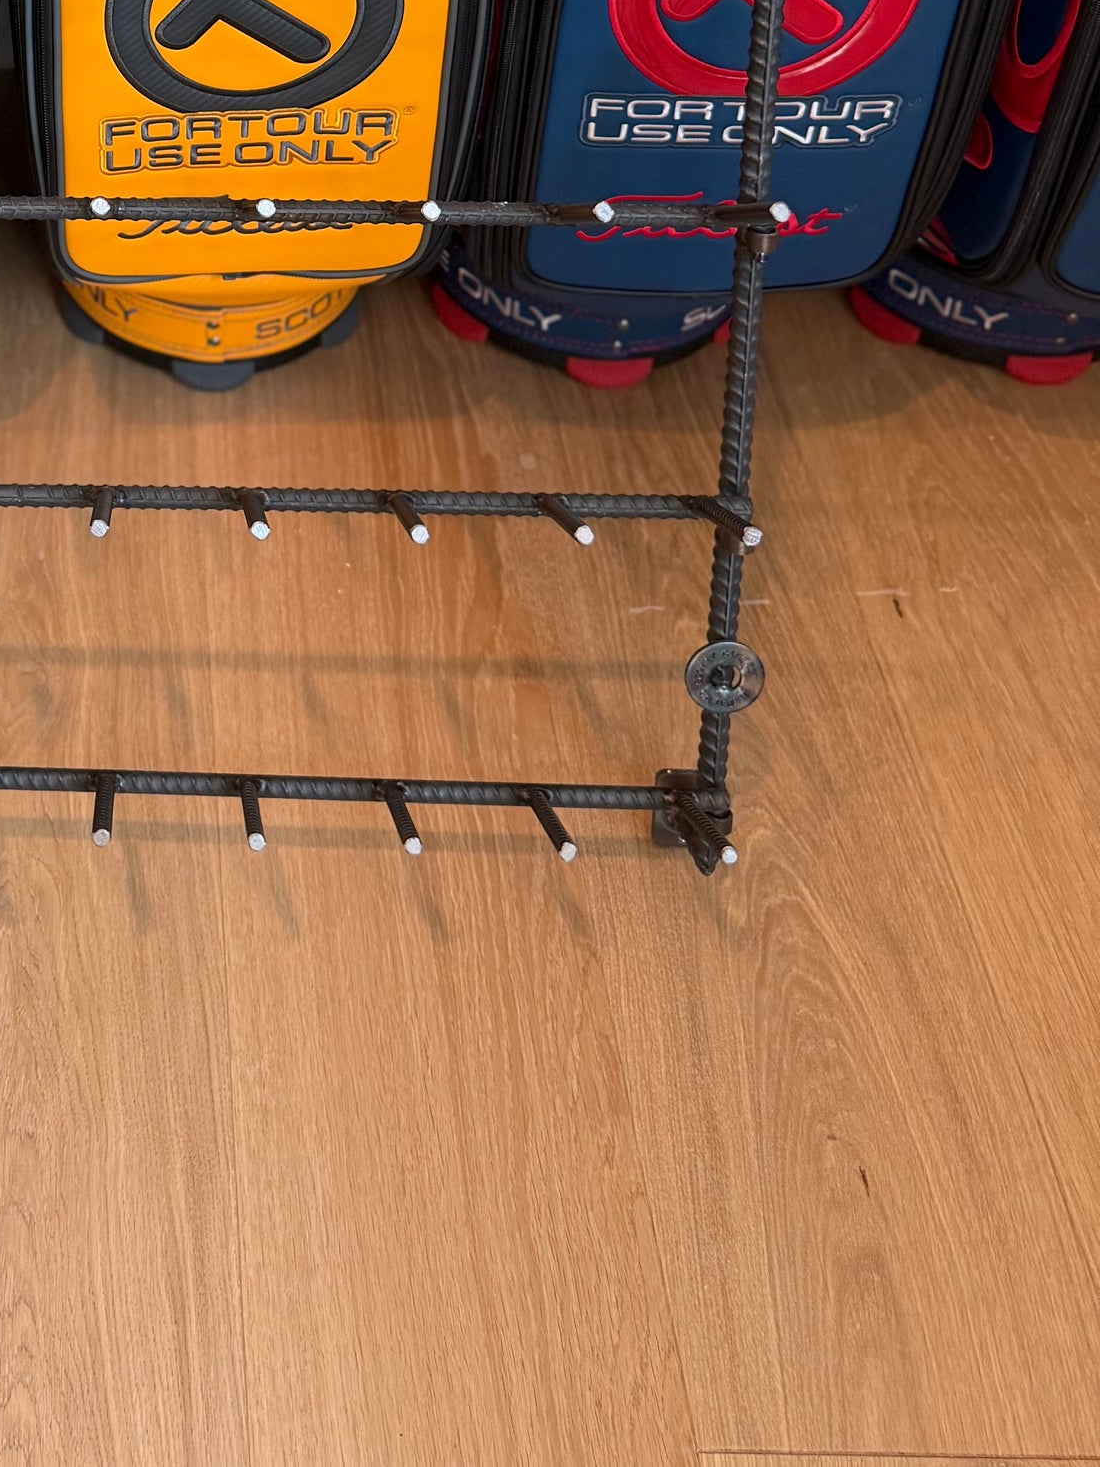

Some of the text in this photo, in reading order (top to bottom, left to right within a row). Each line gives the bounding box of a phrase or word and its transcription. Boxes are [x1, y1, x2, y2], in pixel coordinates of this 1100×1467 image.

[104, 139, 392, 172] USE ONLY
[587, 122, 714, 143] USE
[457, 266, 563, 332] ONLY
[887, 267, 1010, 331] ONLY
